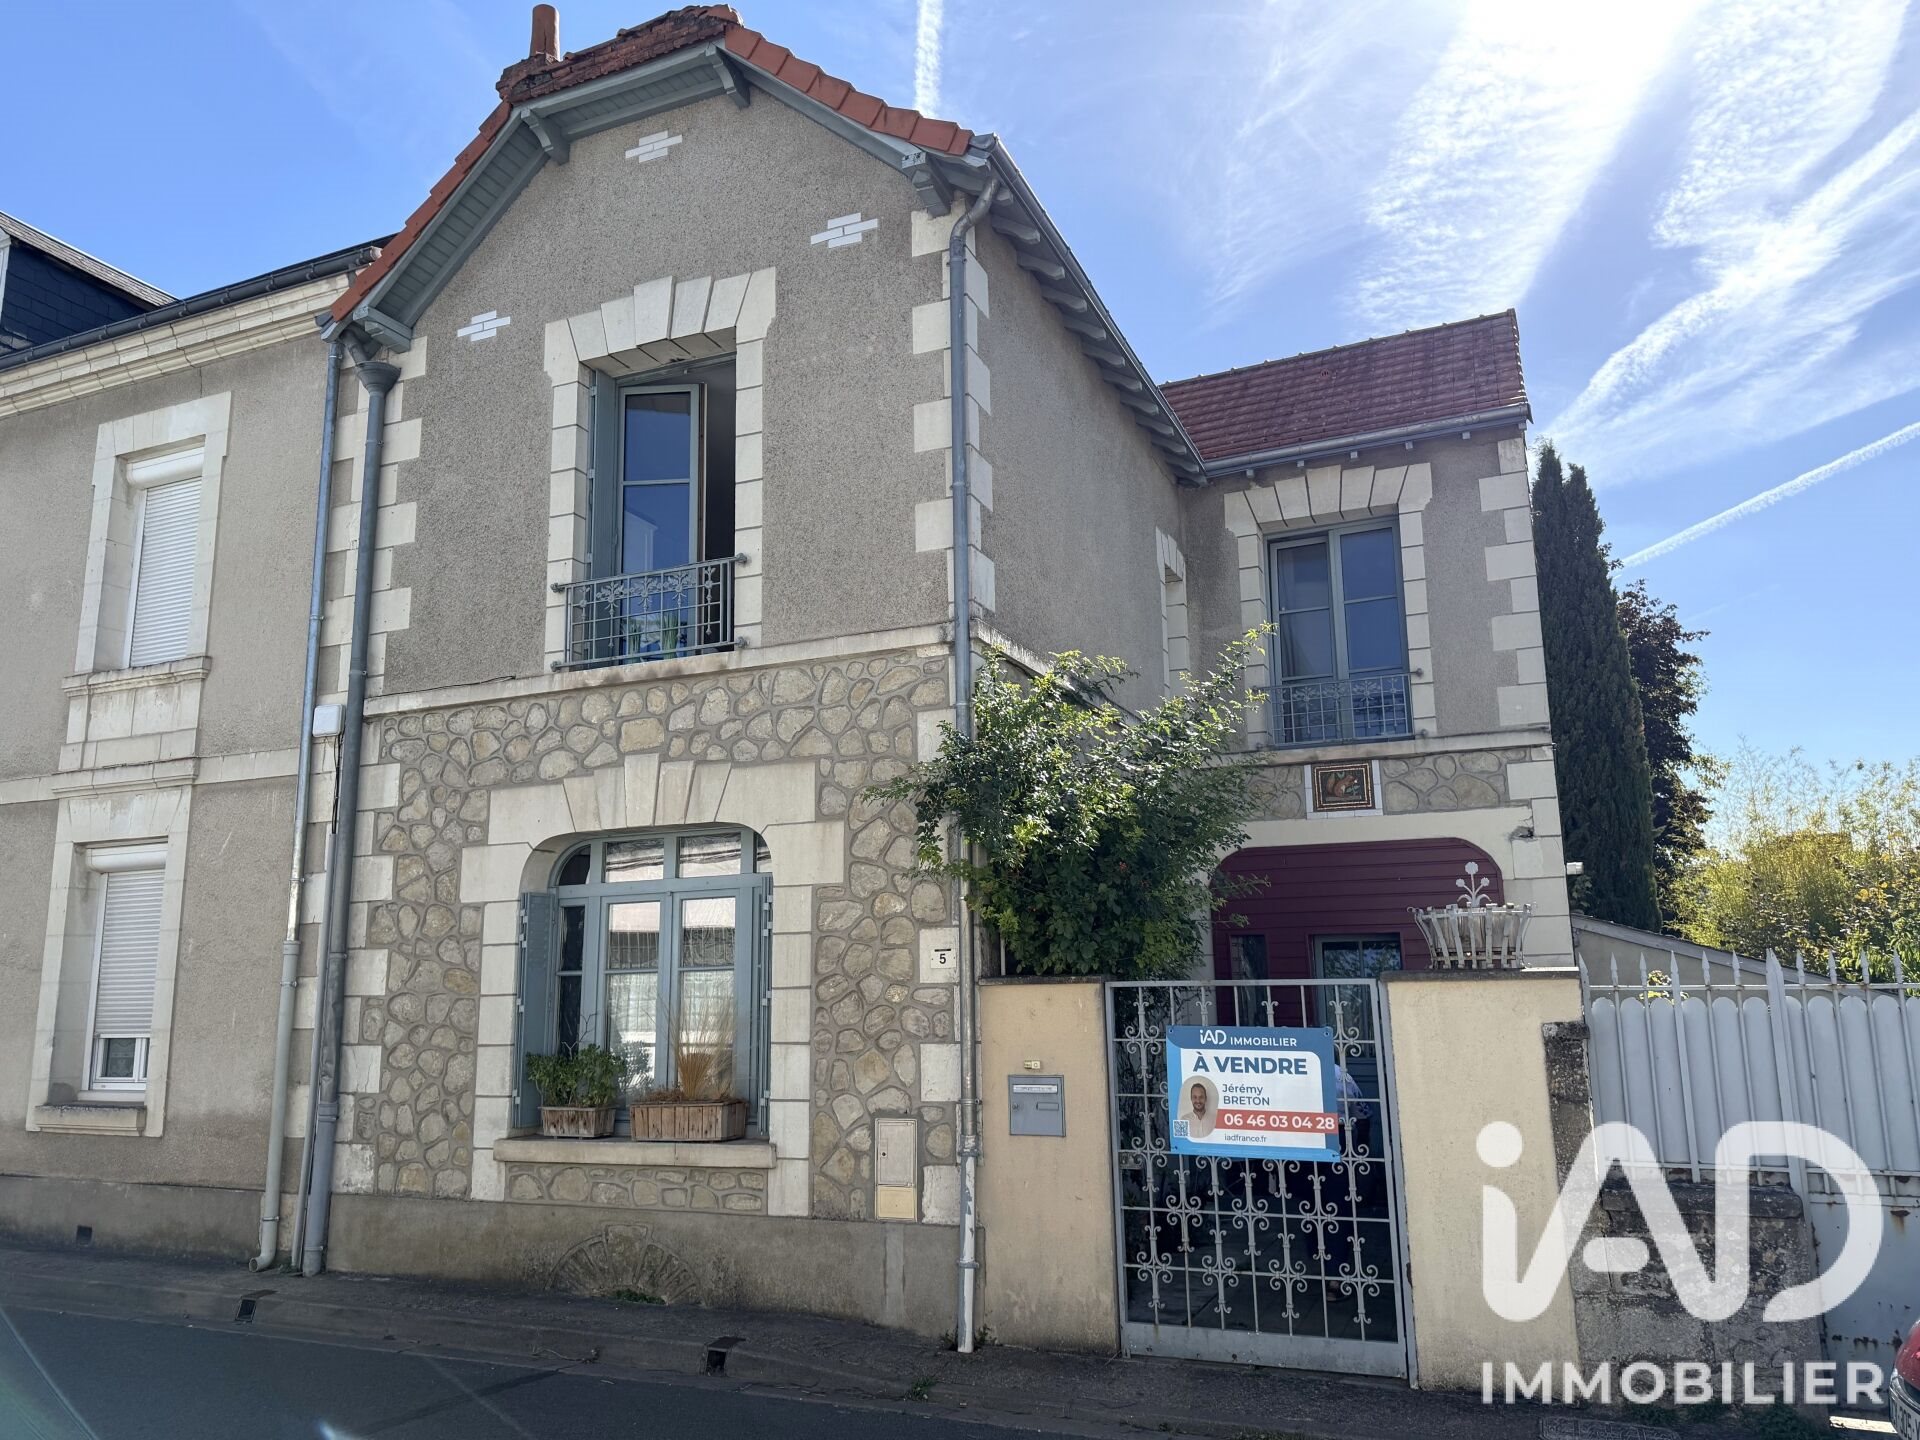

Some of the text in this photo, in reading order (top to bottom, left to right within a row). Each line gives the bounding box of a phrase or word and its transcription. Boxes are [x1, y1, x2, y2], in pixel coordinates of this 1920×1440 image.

[939, 953, 946, 965] 5
[1230, 1036, 1297, 1047] IMMOBILIER
[1193, 1051, 1308, 1075] À VENDRE
[1222, 1084, 1264, 1096] Jérémy
[1223, 1095, 1270, 1106] BRETON
[1223, 1113, 1335, 1130] 06 46 03 04 28
[1224, 1133, 1267, 1143] iadfrance.fr
